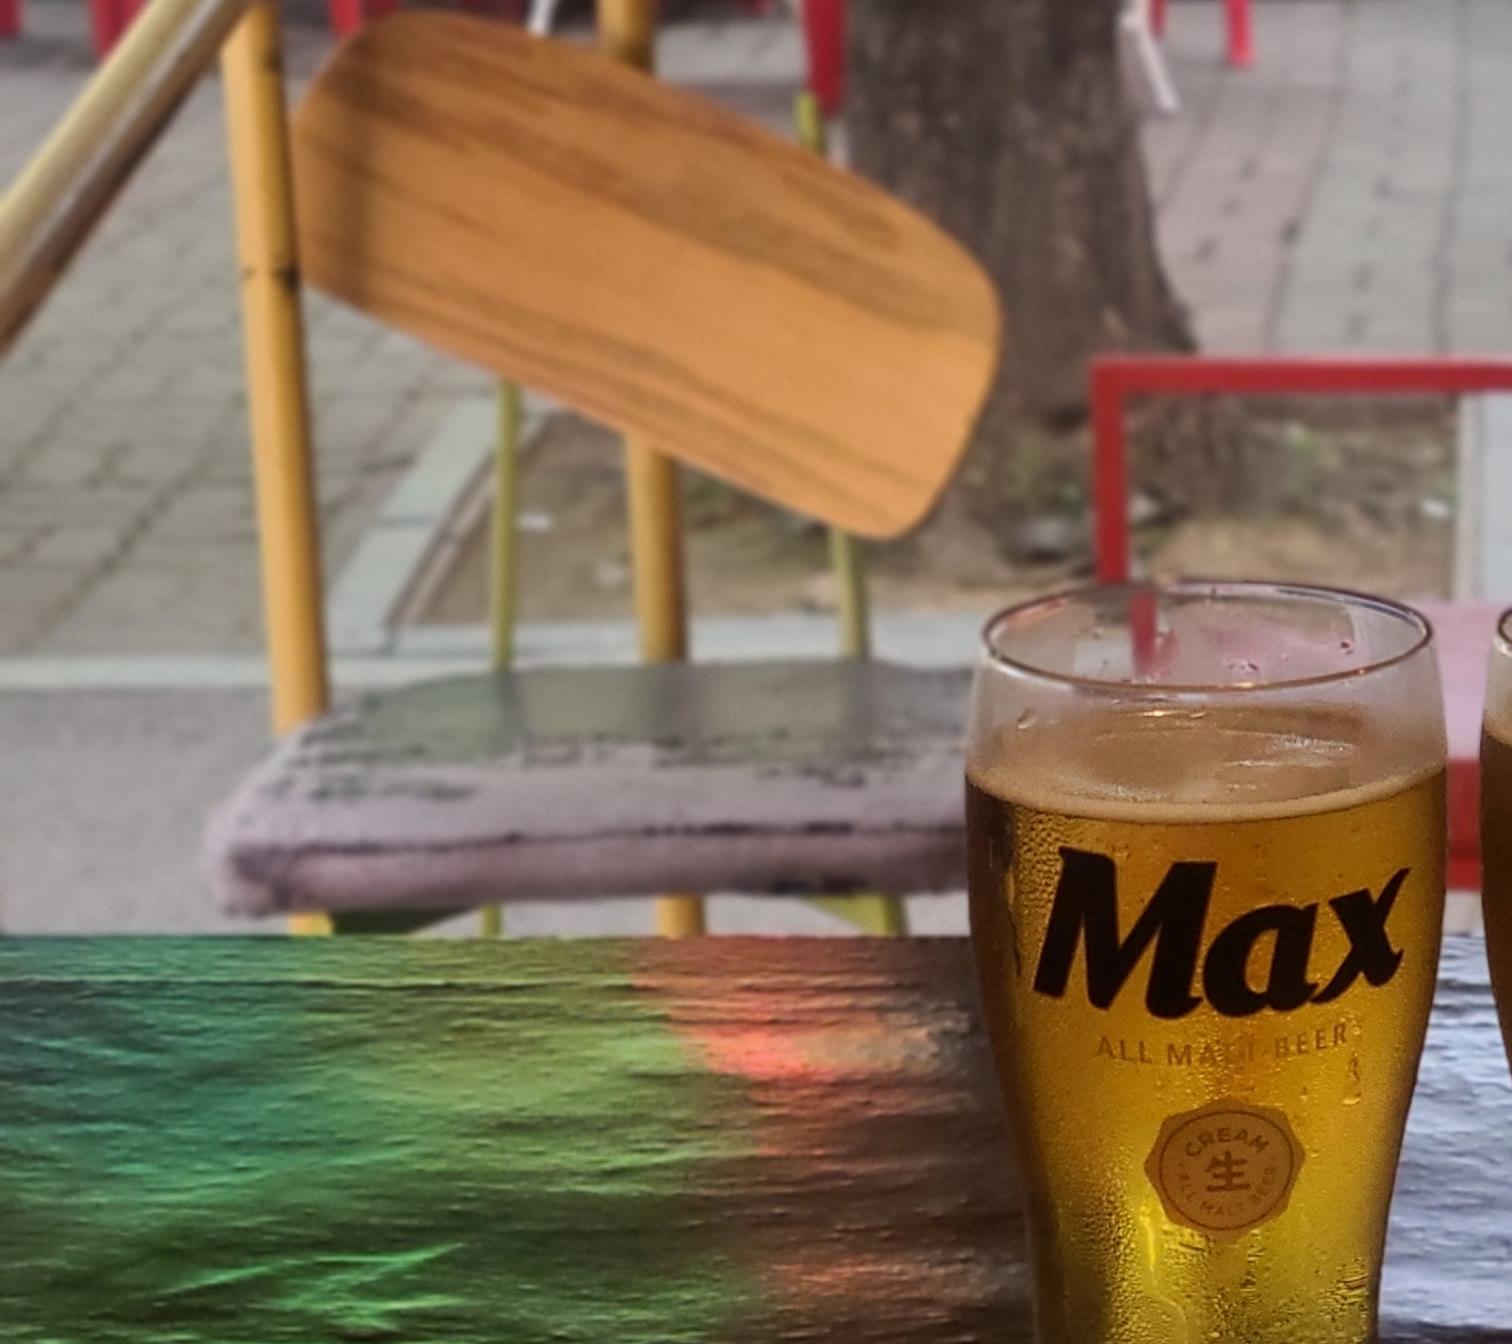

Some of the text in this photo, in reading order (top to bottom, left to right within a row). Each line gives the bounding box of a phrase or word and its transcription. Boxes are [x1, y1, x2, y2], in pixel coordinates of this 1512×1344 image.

[1033, 847, 1411, 1019] Max
[1097, 1034, 1152, 1064] ALL
[1274, 1022, 1348, 1060] BEER
[1185, 1127, 1269, 1158] CREAM
[1206, 1150, 1251, 1193] 生
